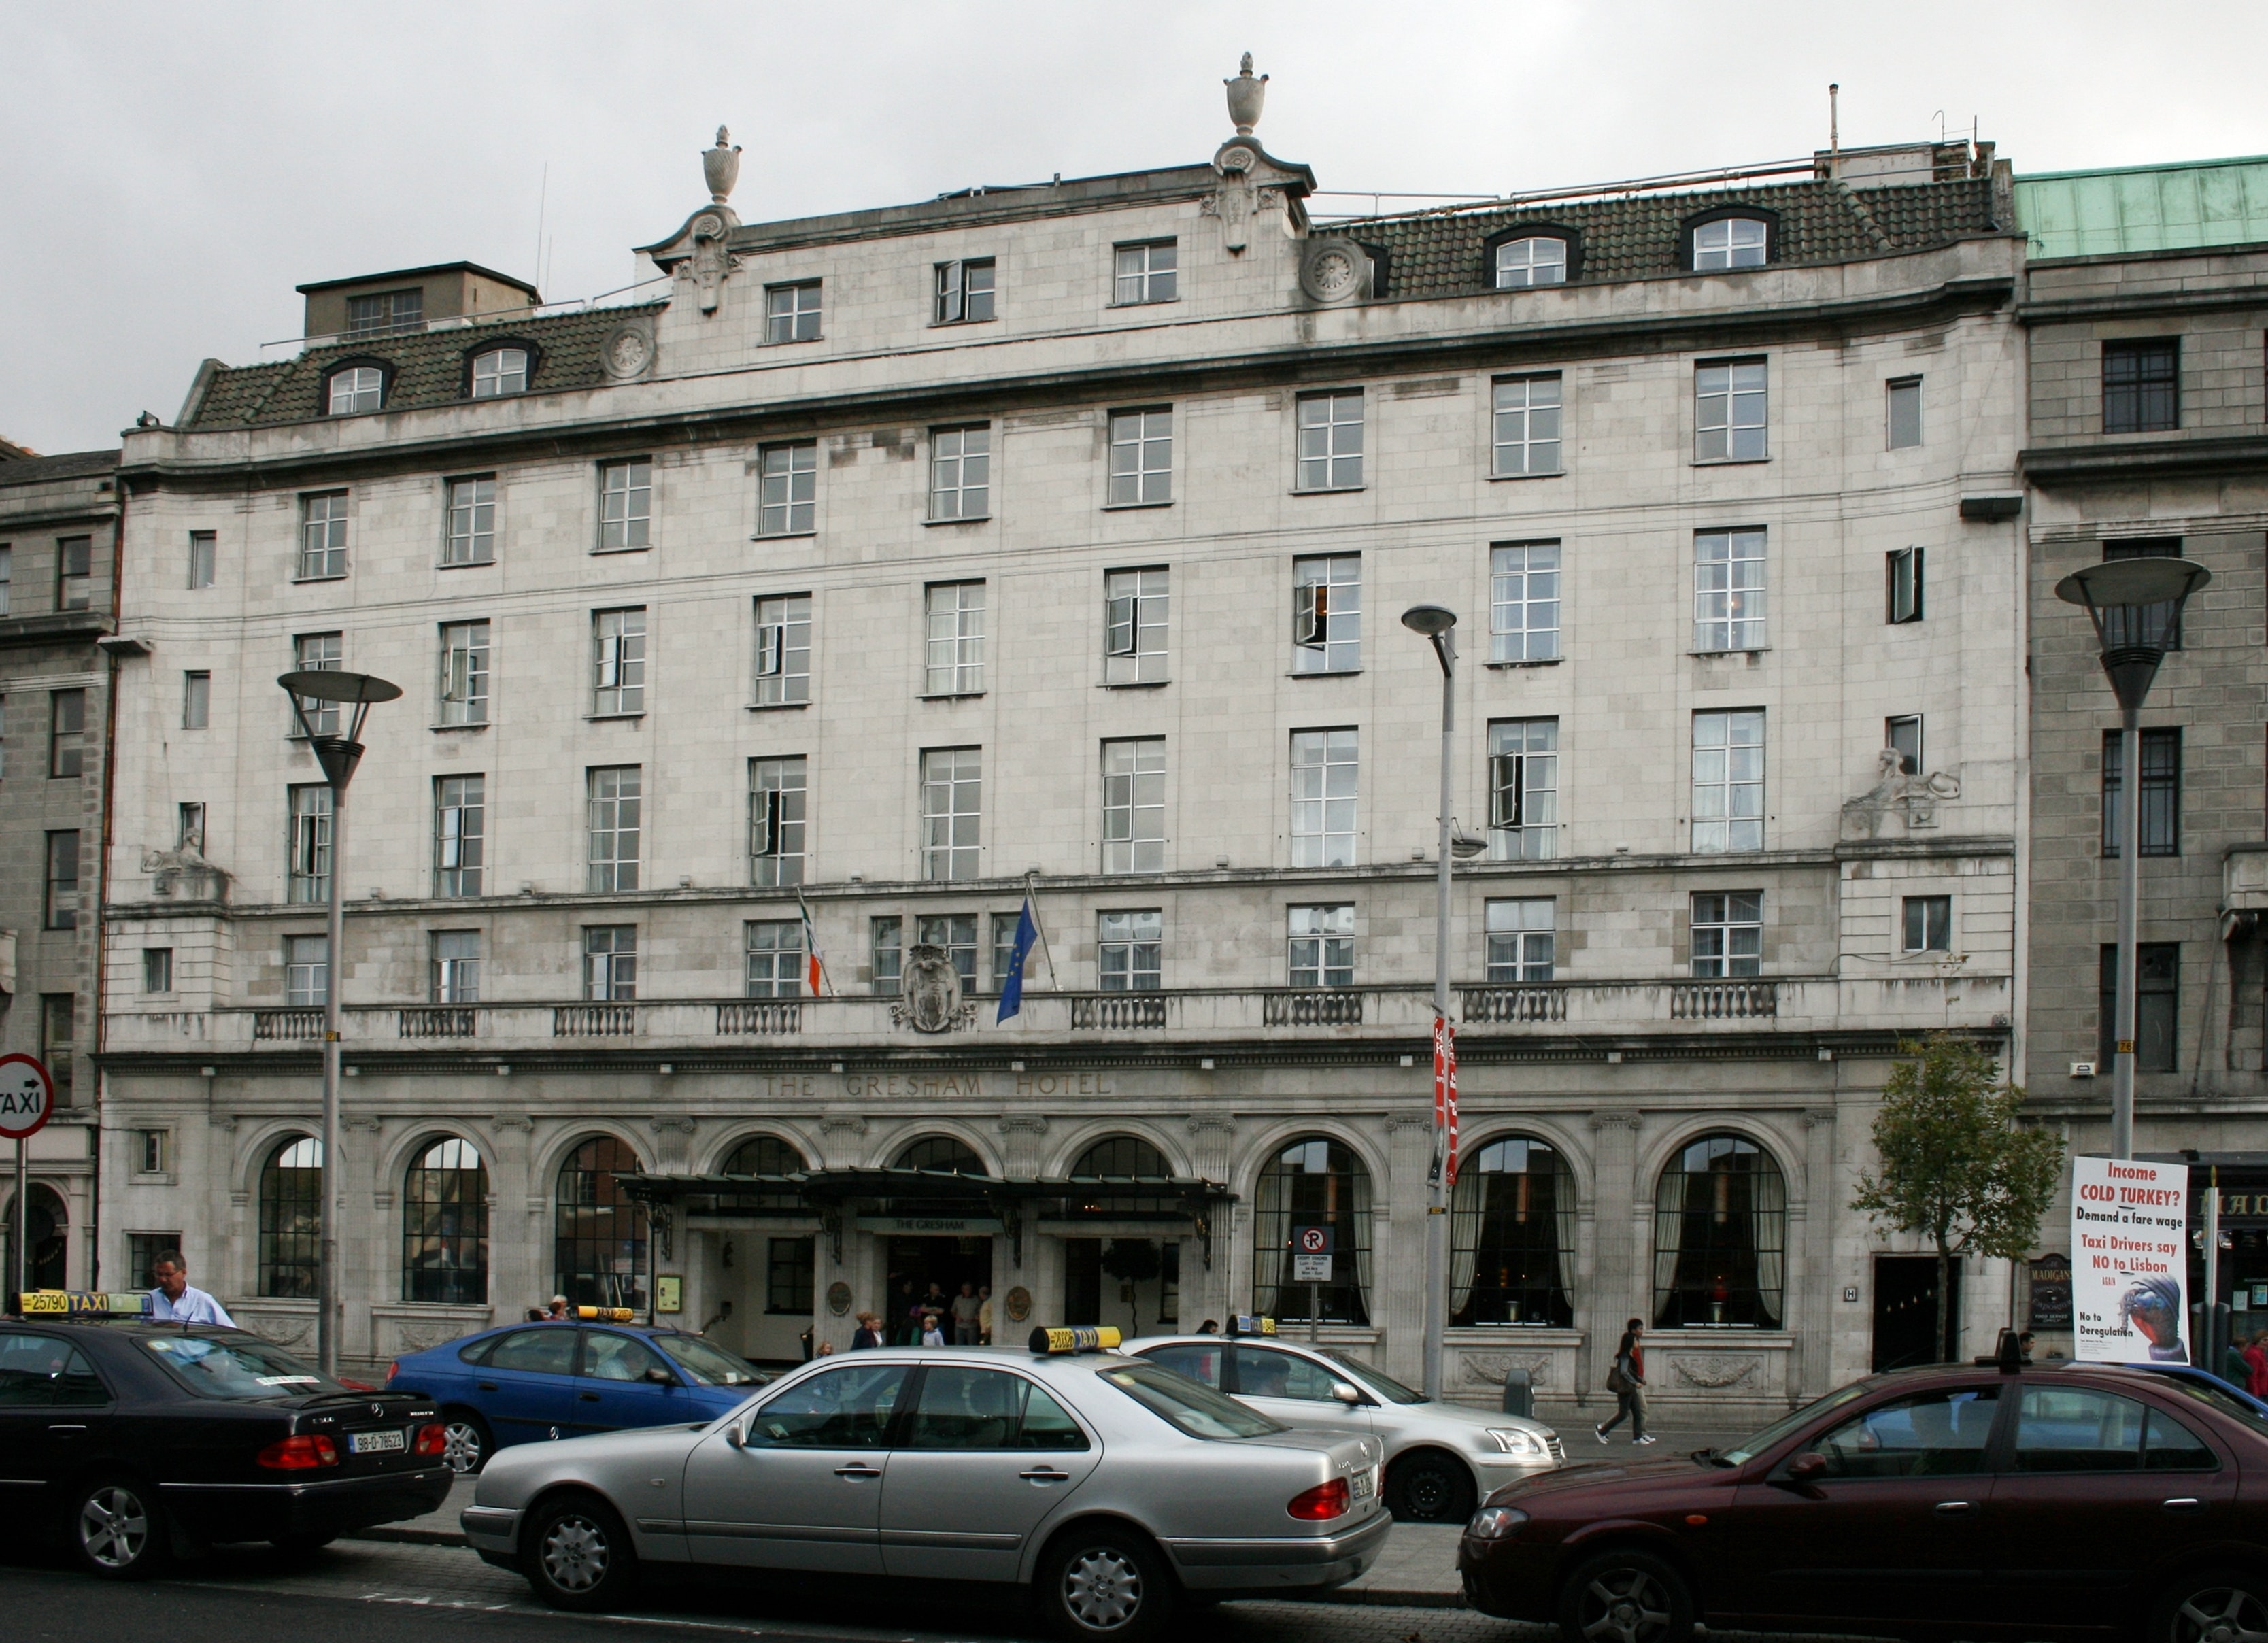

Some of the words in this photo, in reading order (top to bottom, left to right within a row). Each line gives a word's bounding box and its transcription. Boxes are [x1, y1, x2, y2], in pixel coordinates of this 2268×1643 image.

[2120, 1042, 2132, 1051] 76
[763, 1074, 815, 1096] THE
[846, 1075, 981, 1096] GRESHAM
[1016, 1073, 1112, 1095] HOTEL
[2108, 1162, 2157, 1181] Income
[2080, 1184, 2115, 1202] COLD
[2120, 1187, 2180, 1207] TURKEY?
[896, 1219, 914, 1230] THE
[916, 1219, 964, 1230] GRESHAM
[2076, 1206, 2119, 1223] Demand
[2122, 1215, 2129, 1223] a
[2132, 1211, 2152, 1225] fare
[2156, 1217, 2183, 1230] wage
[2082, 1234, 2106, 1249] Taxi
[2110, 1236, 2153, 1252] Drivers
[2156, 1242, 2177, 1257] say
[2093, 1255, 2110, 1269] NO
[2114, 1257, 2126, 1270] to
[2130, 1257, 2168, 1273] Lisbon
[2102, 1276, 2116, 1286] AGAIN
[32, 1295, 66, 1310] 25790
[70, 1295, 109, 1312] TAXI
[2080, 1312, 2091, 1321] No
[2093, 1312, 2101, 1322] to
[1075, 1329, 1096, 1347] TAXI
[2080, 1325, 2133, 1338] Deregulation
[358, 1434, 403, 1451] 98-D-78523
